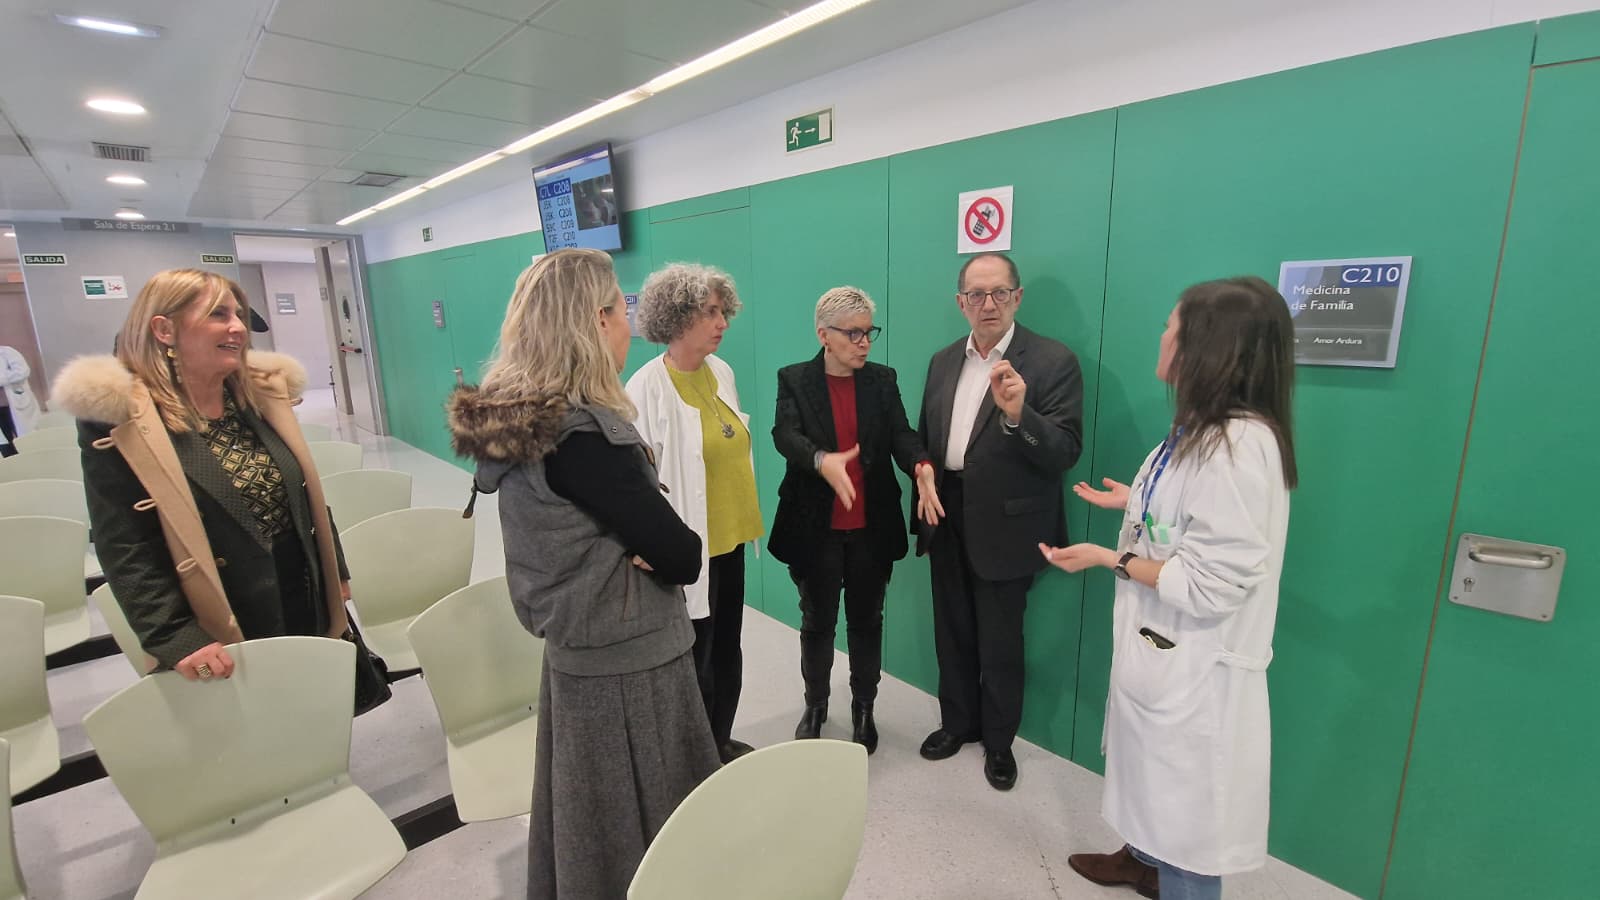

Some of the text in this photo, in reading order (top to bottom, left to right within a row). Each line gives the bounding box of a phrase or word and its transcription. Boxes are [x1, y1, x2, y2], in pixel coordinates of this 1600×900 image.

[94, 220, 113, 229] Sala
[116, 222, 128, 230] de
[131, 221, 160, 231] Espera
[203, 255, 233, 263] SALIDA
[1342, 266, 1400, 283] C210
[1293, 284, 1351, 295] Medicina
[1290, 299, 1354, 310] de Familia
